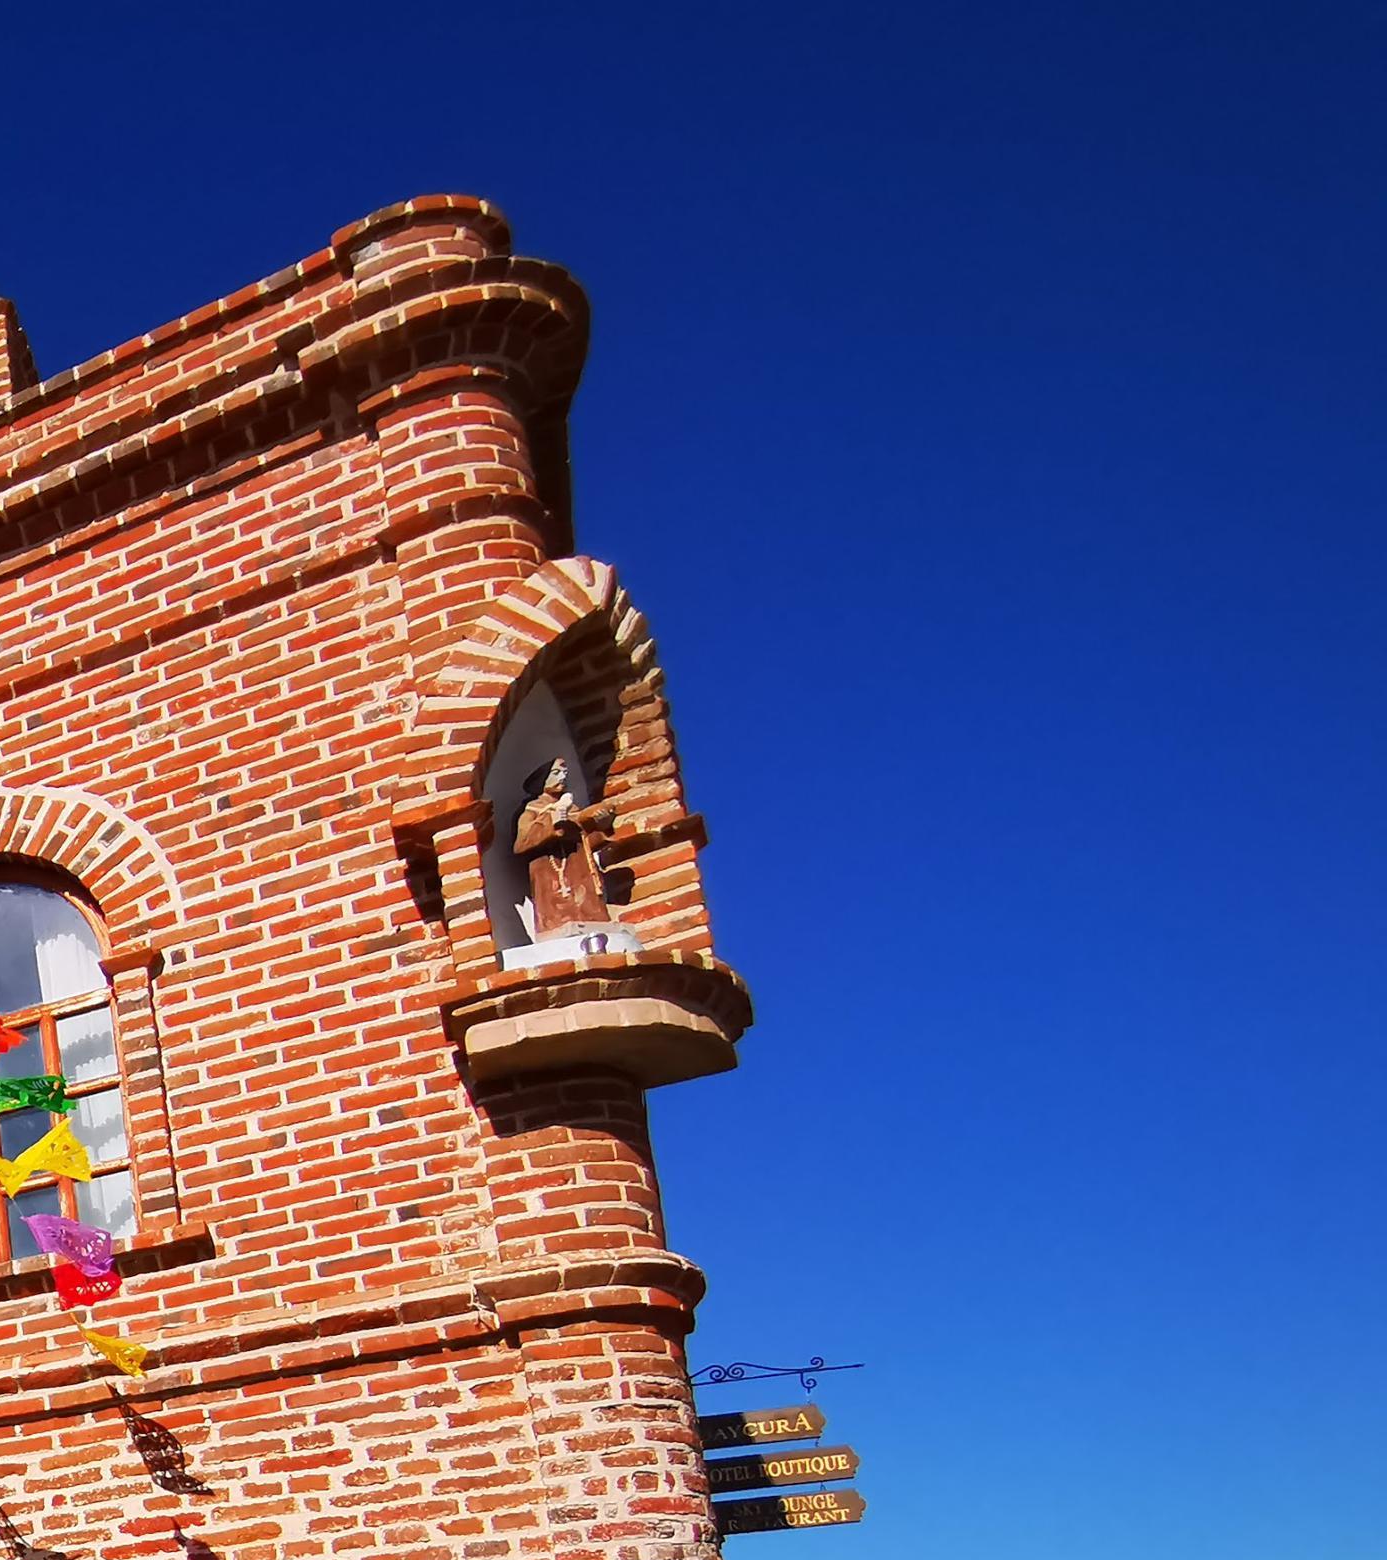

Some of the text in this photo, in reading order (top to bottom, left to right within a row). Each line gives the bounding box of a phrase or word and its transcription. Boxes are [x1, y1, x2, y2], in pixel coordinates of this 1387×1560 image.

[714, 1412, 814, 1440] AYCURA
[709, 1454, 851, 1483] OTEL BOUTIQUE
[727, 1508, 851, 1533] RTAURANT
